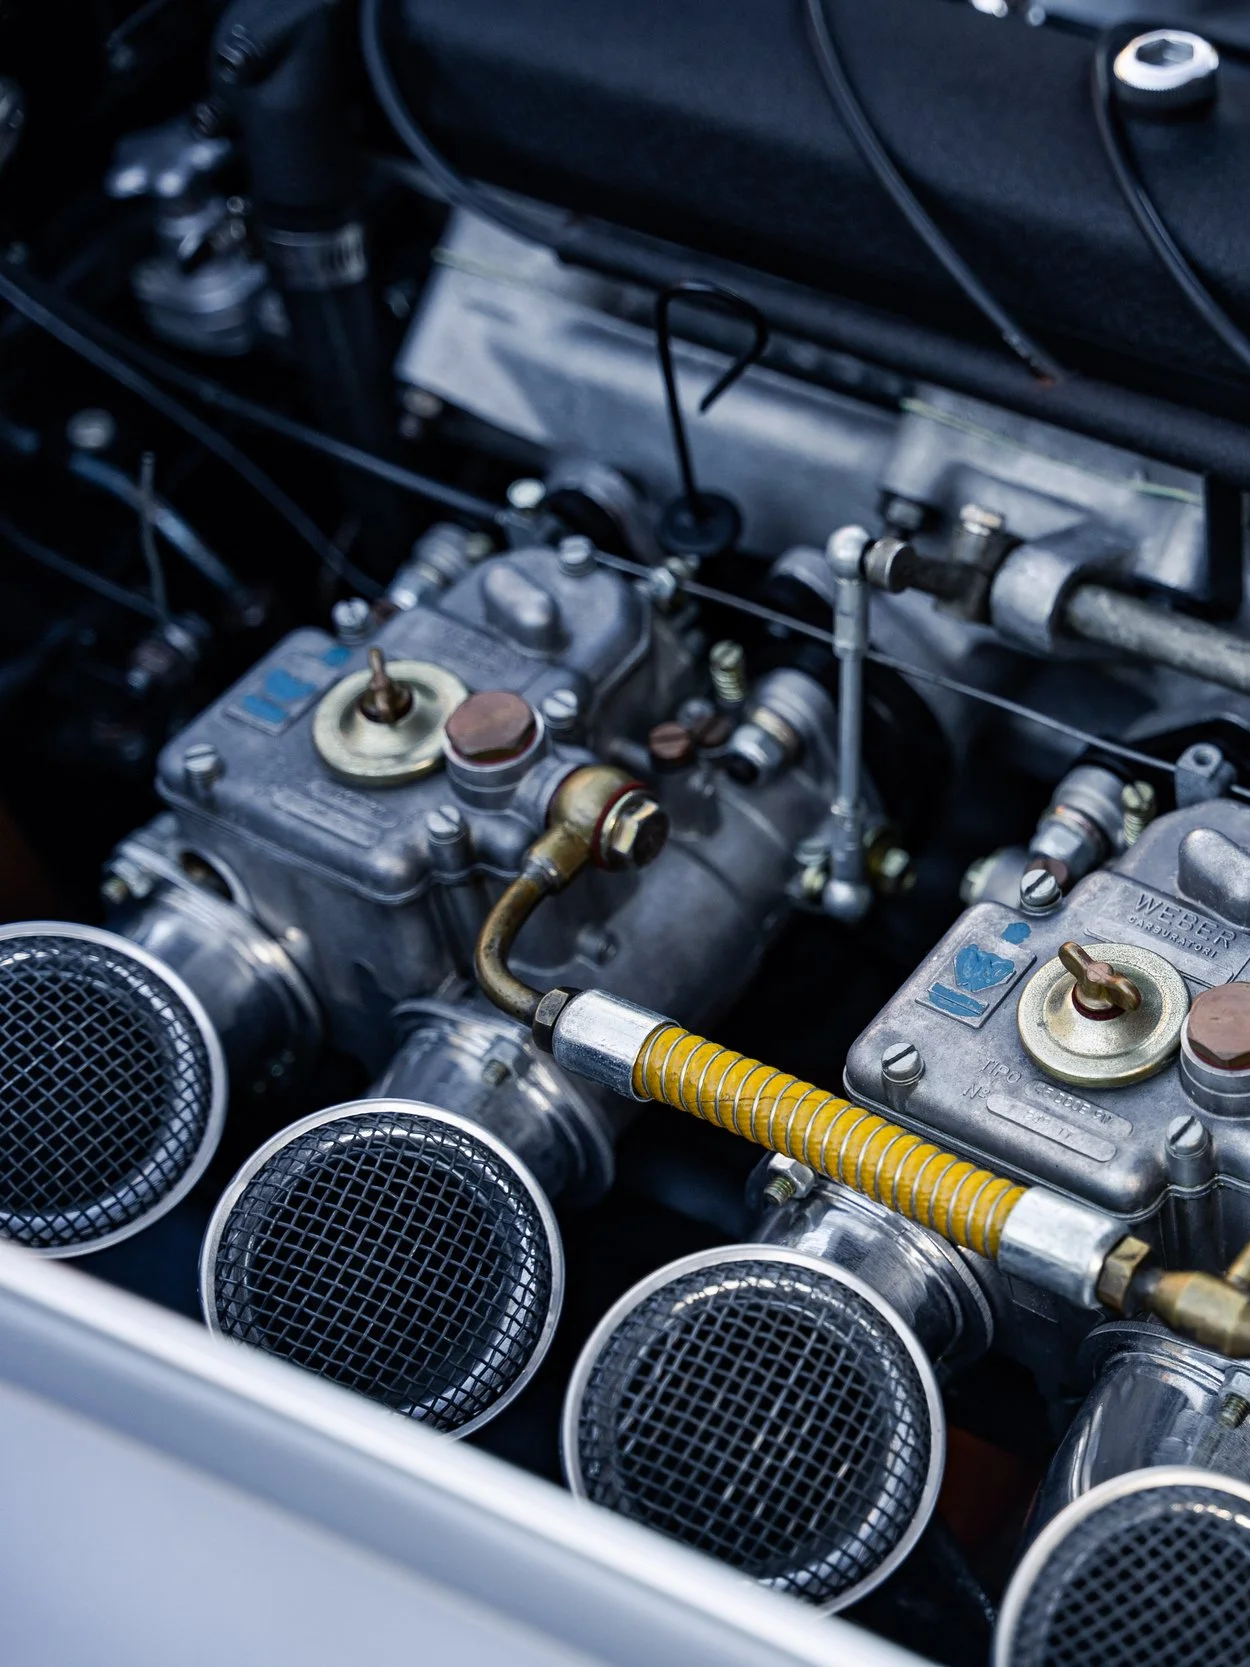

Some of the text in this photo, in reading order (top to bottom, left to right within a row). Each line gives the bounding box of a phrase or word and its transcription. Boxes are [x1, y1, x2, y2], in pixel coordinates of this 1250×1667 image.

[1128, 915, 1218, 958] CARBURATORI
[1135, 894, 1237, 949] WEBER
[980, 1057, 1022, 1084] TIPO
